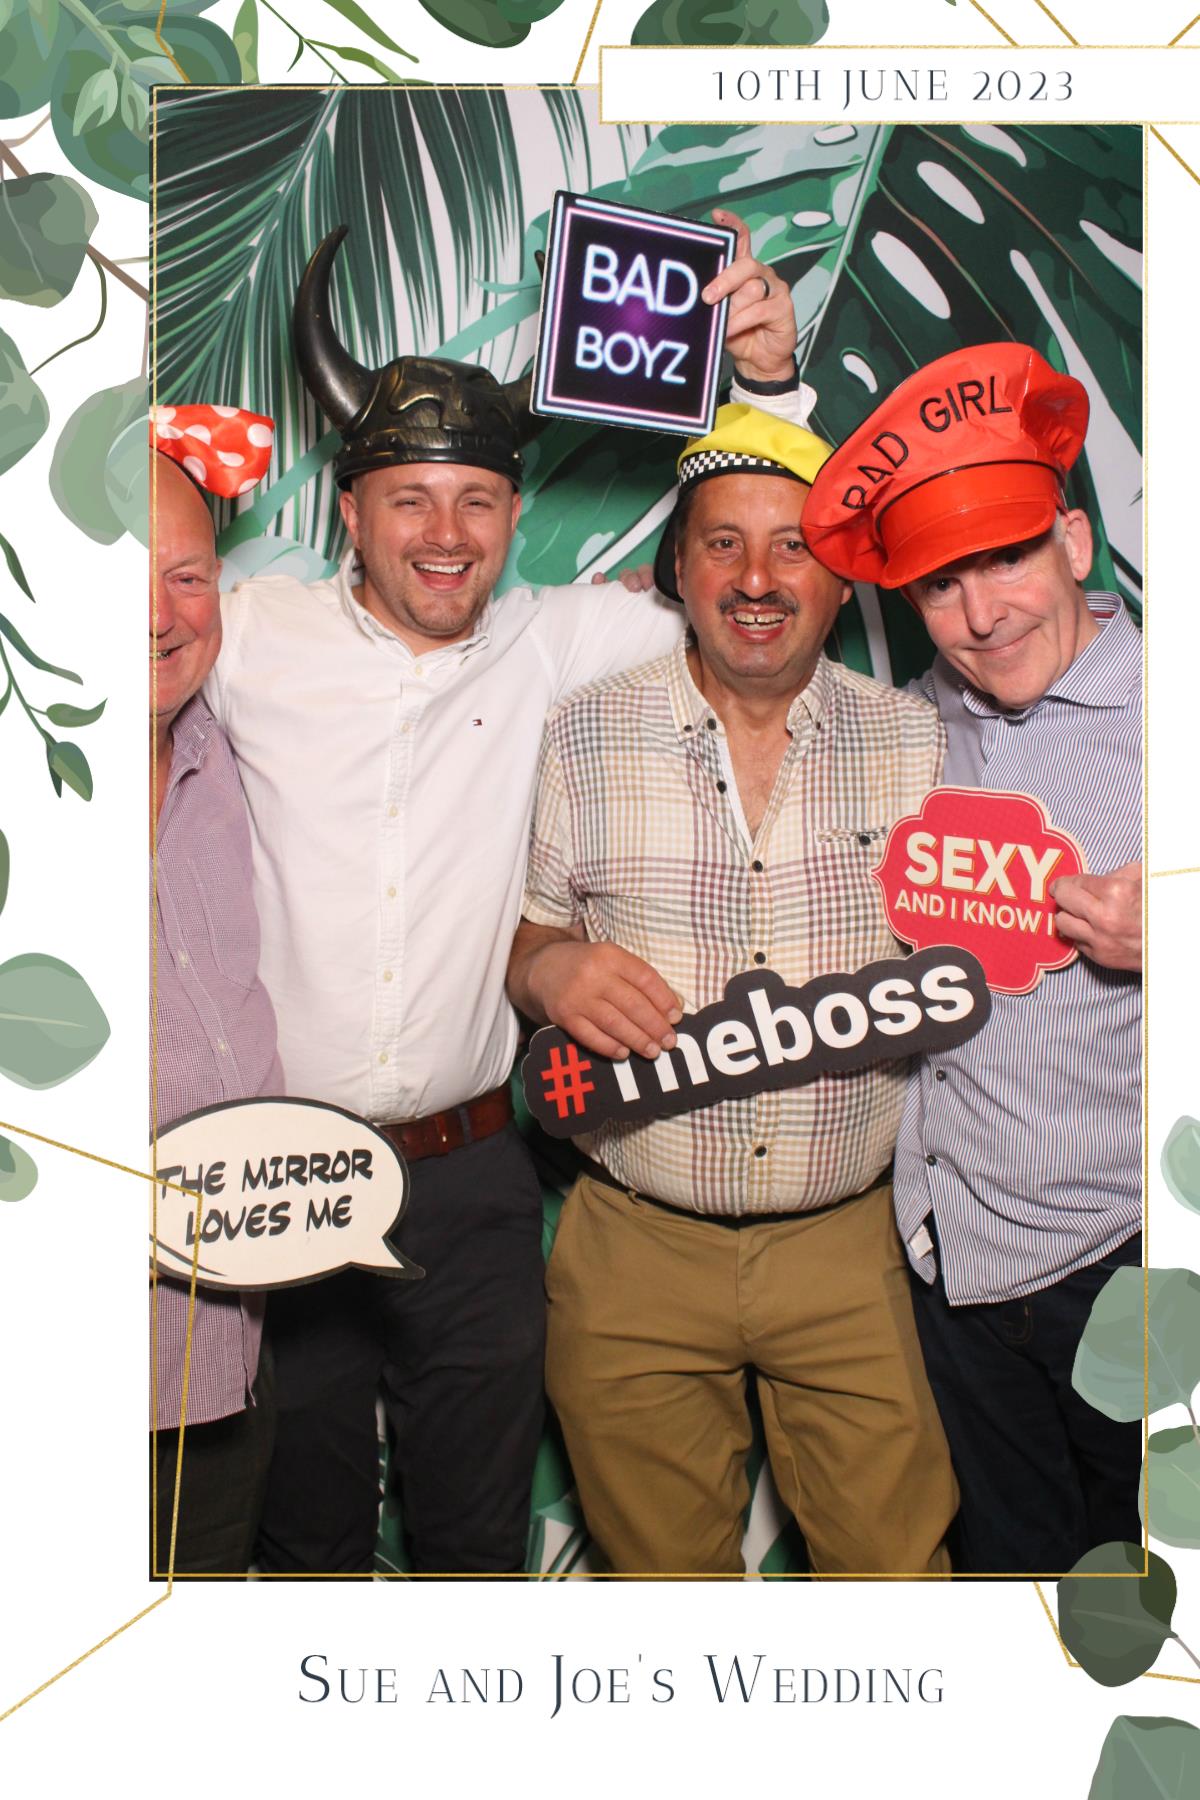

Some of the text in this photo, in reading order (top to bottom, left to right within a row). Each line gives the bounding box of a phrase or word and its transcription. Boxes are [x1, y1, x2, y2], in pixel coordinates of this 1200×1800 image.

[582, 243, 699, 316] BAD
[575, 325, 690, 384] BOYZ
[919, 375, 1013, 433] GIRL
[904, 831, 1062, 904] SEXY
[894, 889, 946, 918] AND
[950, 897, 957, 920] I
[963, 900, 1042, 936] KNOW
[156, 1149, 373, 1200] THE MIRROR
[185, 1195, 353, 1246] LOVES ME
